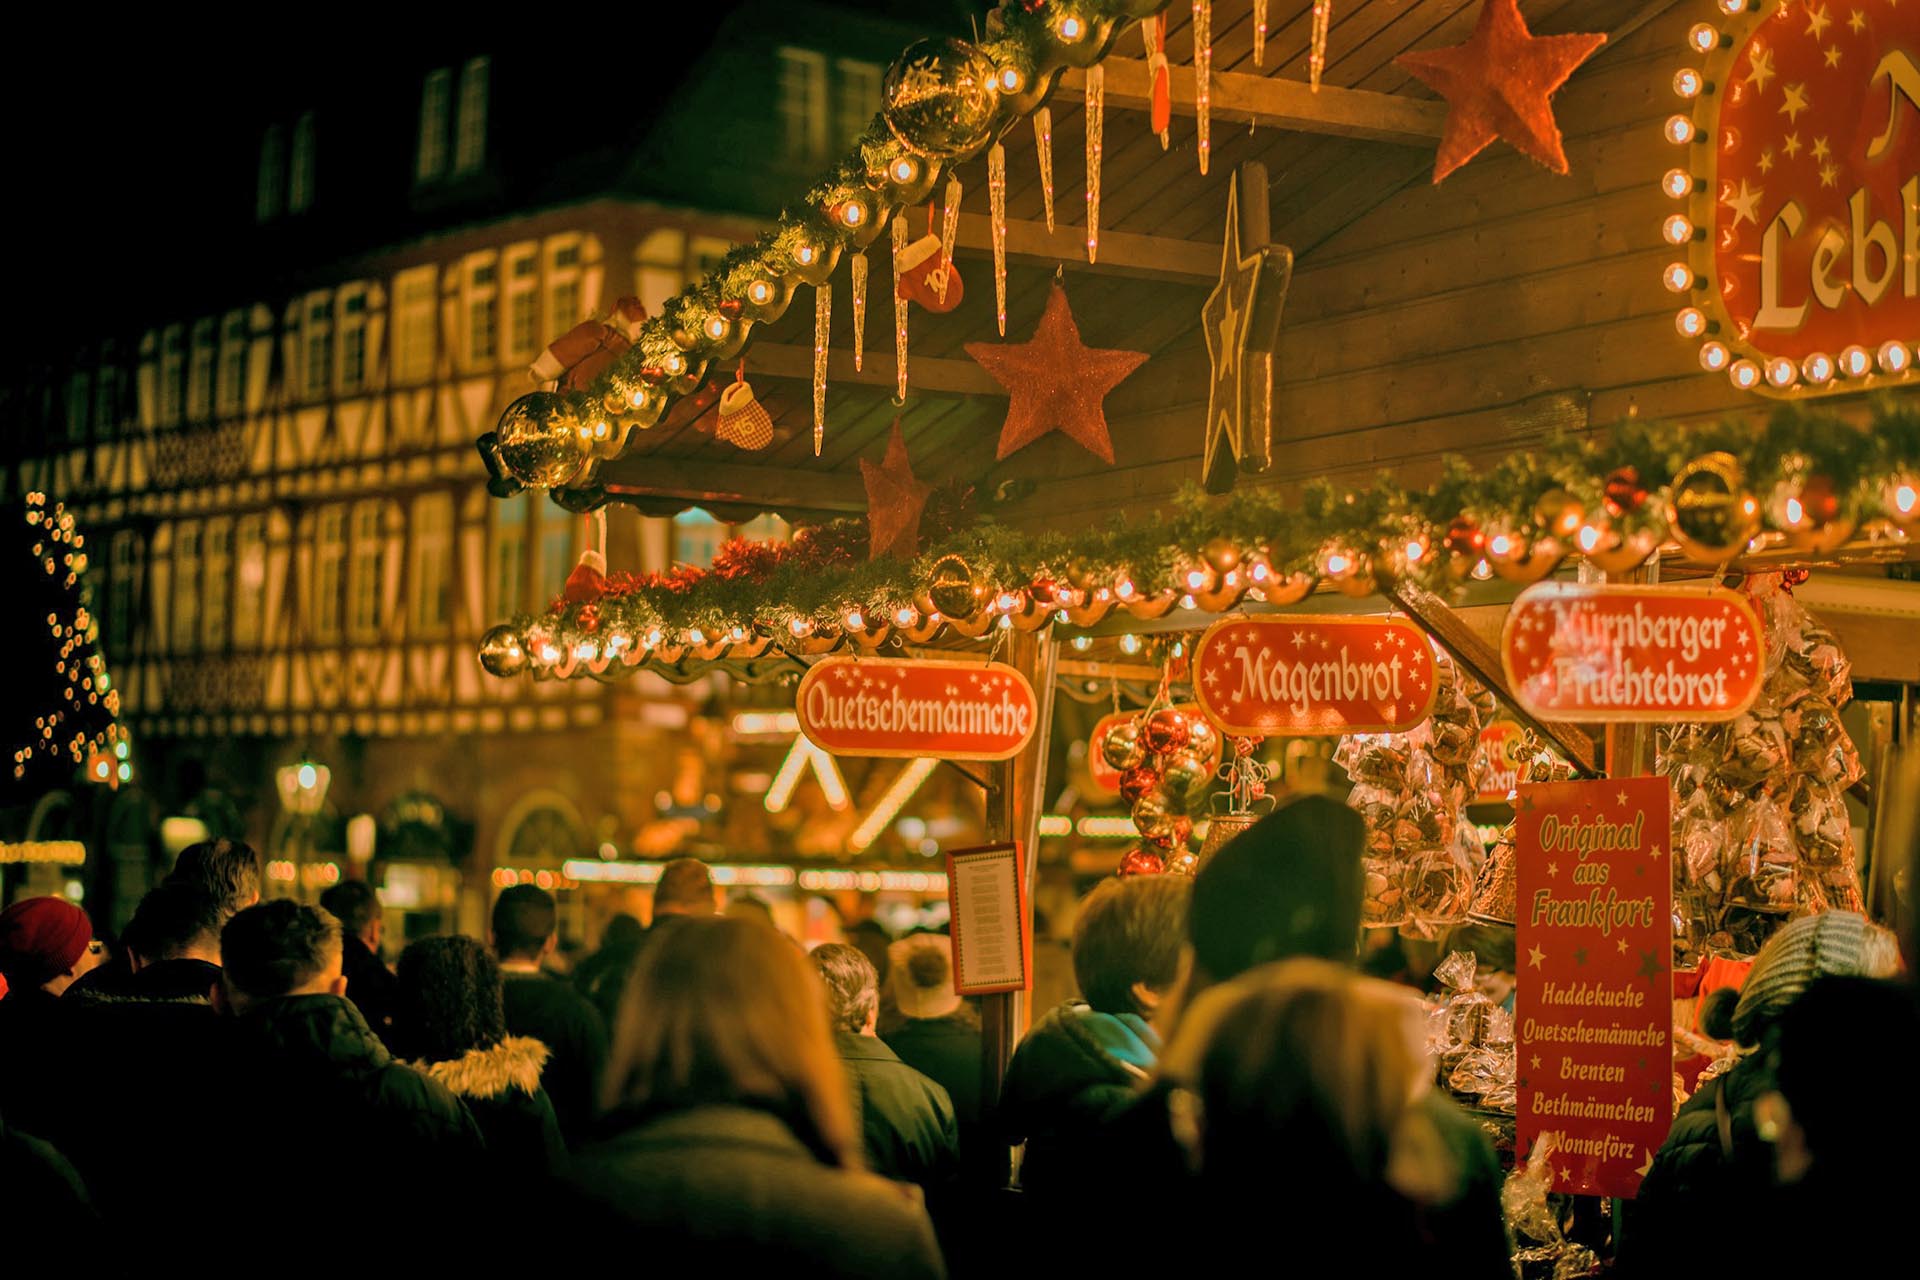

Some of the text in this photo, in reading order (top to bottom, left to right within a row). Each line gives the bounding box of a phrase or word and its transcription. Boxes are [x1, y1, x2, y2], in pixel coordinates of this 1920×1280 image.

[1549, 601, 1727, 662] Nürnberger
[1231, 645, 1403, 718] Magenbrot
[806, 679, 1028, 737] Quetschemännche
[1539, 809, 1645, 862] Original
[1572, 862, 1610, 885] aus
[1530, 886, 1655, 937] Frankfort
[1541, 981, 1645, 1009] Haddekuche
[1521, 1018, 1666, 1048] Quetschemännche
[1560, 1056, 1626, 1083] Brenten
[1531, 1090, 1656, 1123] Bethmännchen
